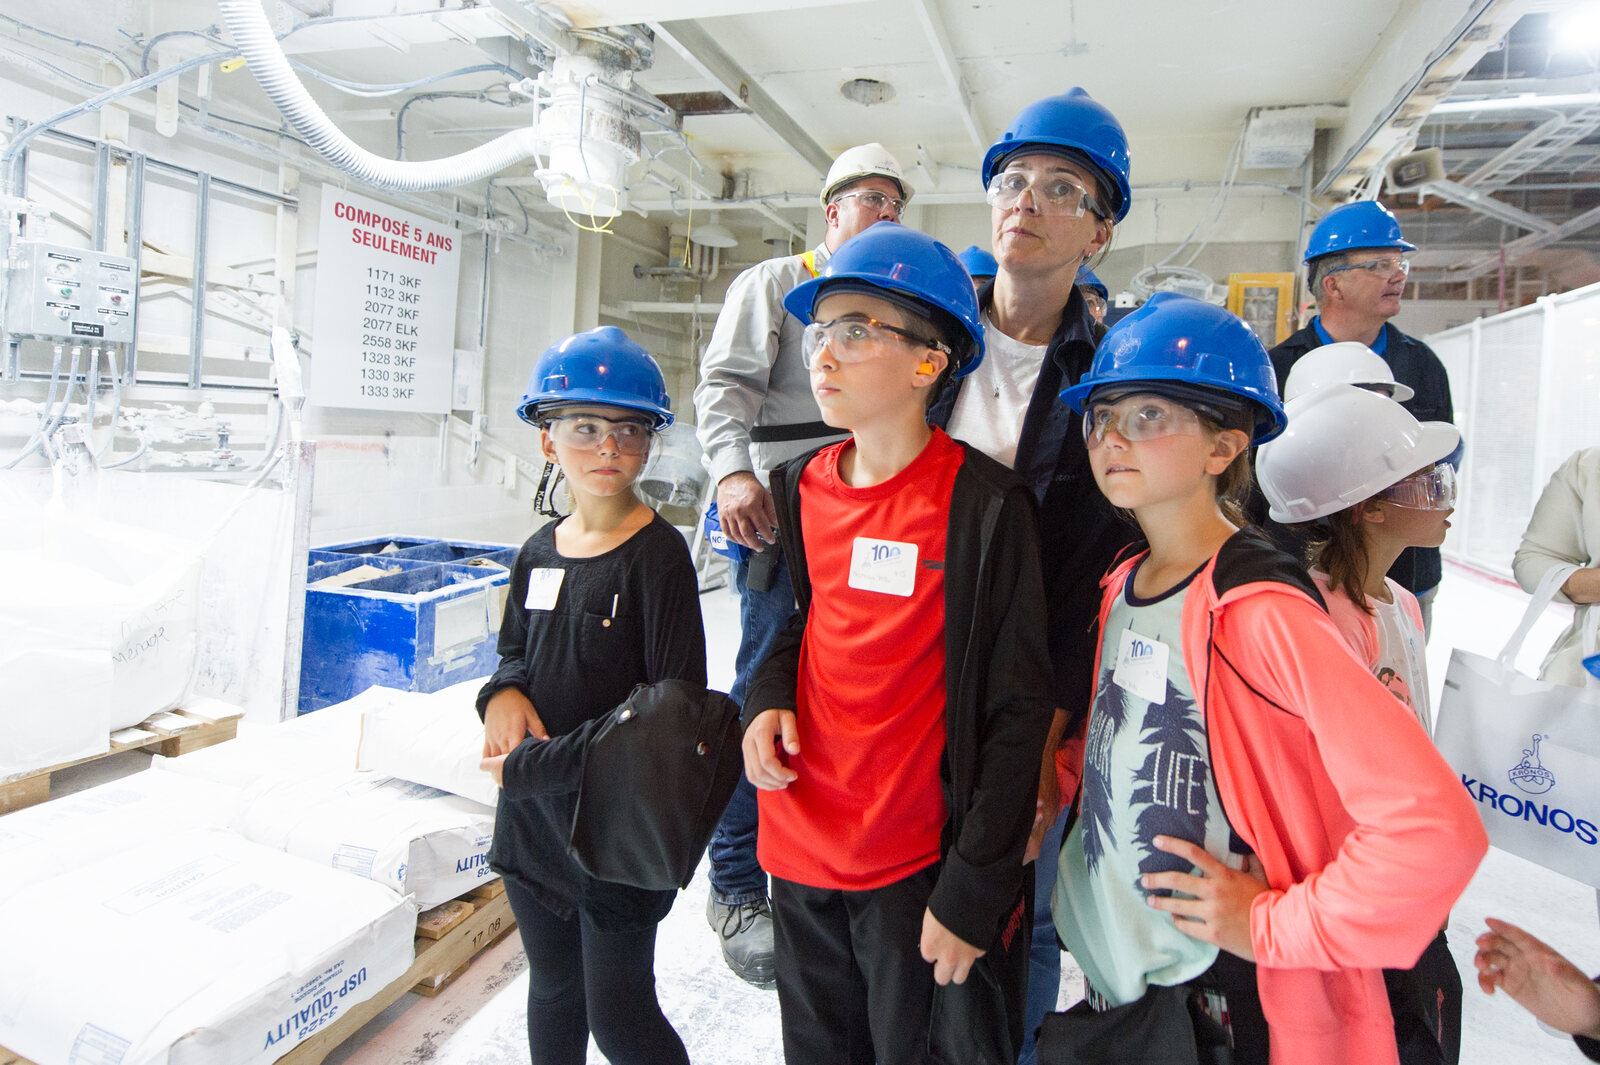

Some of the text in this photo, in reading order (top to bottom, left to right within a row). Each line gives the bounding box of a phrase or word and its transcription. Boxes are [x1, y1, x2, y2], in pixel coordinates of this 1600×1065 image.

[334, 202, 452, 251] COMPOSÉ 5 ANS
[352, 228, 437, 265] SEULEMENT
[367, 267, 421, 289] 1171 3KF
[366, 284, 420, 304] 1132 3KF
[364, 301, 420, 320] 2077 3KF
[363, 317, 418, 336] 2077 ELK
[362, 334, 417, 352] 2558 3KF
[361, 351, 416, 368] 1328 3KF
[361, 368, 415, 383] 1330 3KF
[360, 385, 415, 399] 1333 3KF
[1152, 746, 1203, 815] LIFE
[1512, 768, 1550, 778] KRONOS
[1461, 773, 1599, 845] KRONOS
[263, 967, 366, 1050] USP-QUALITY
